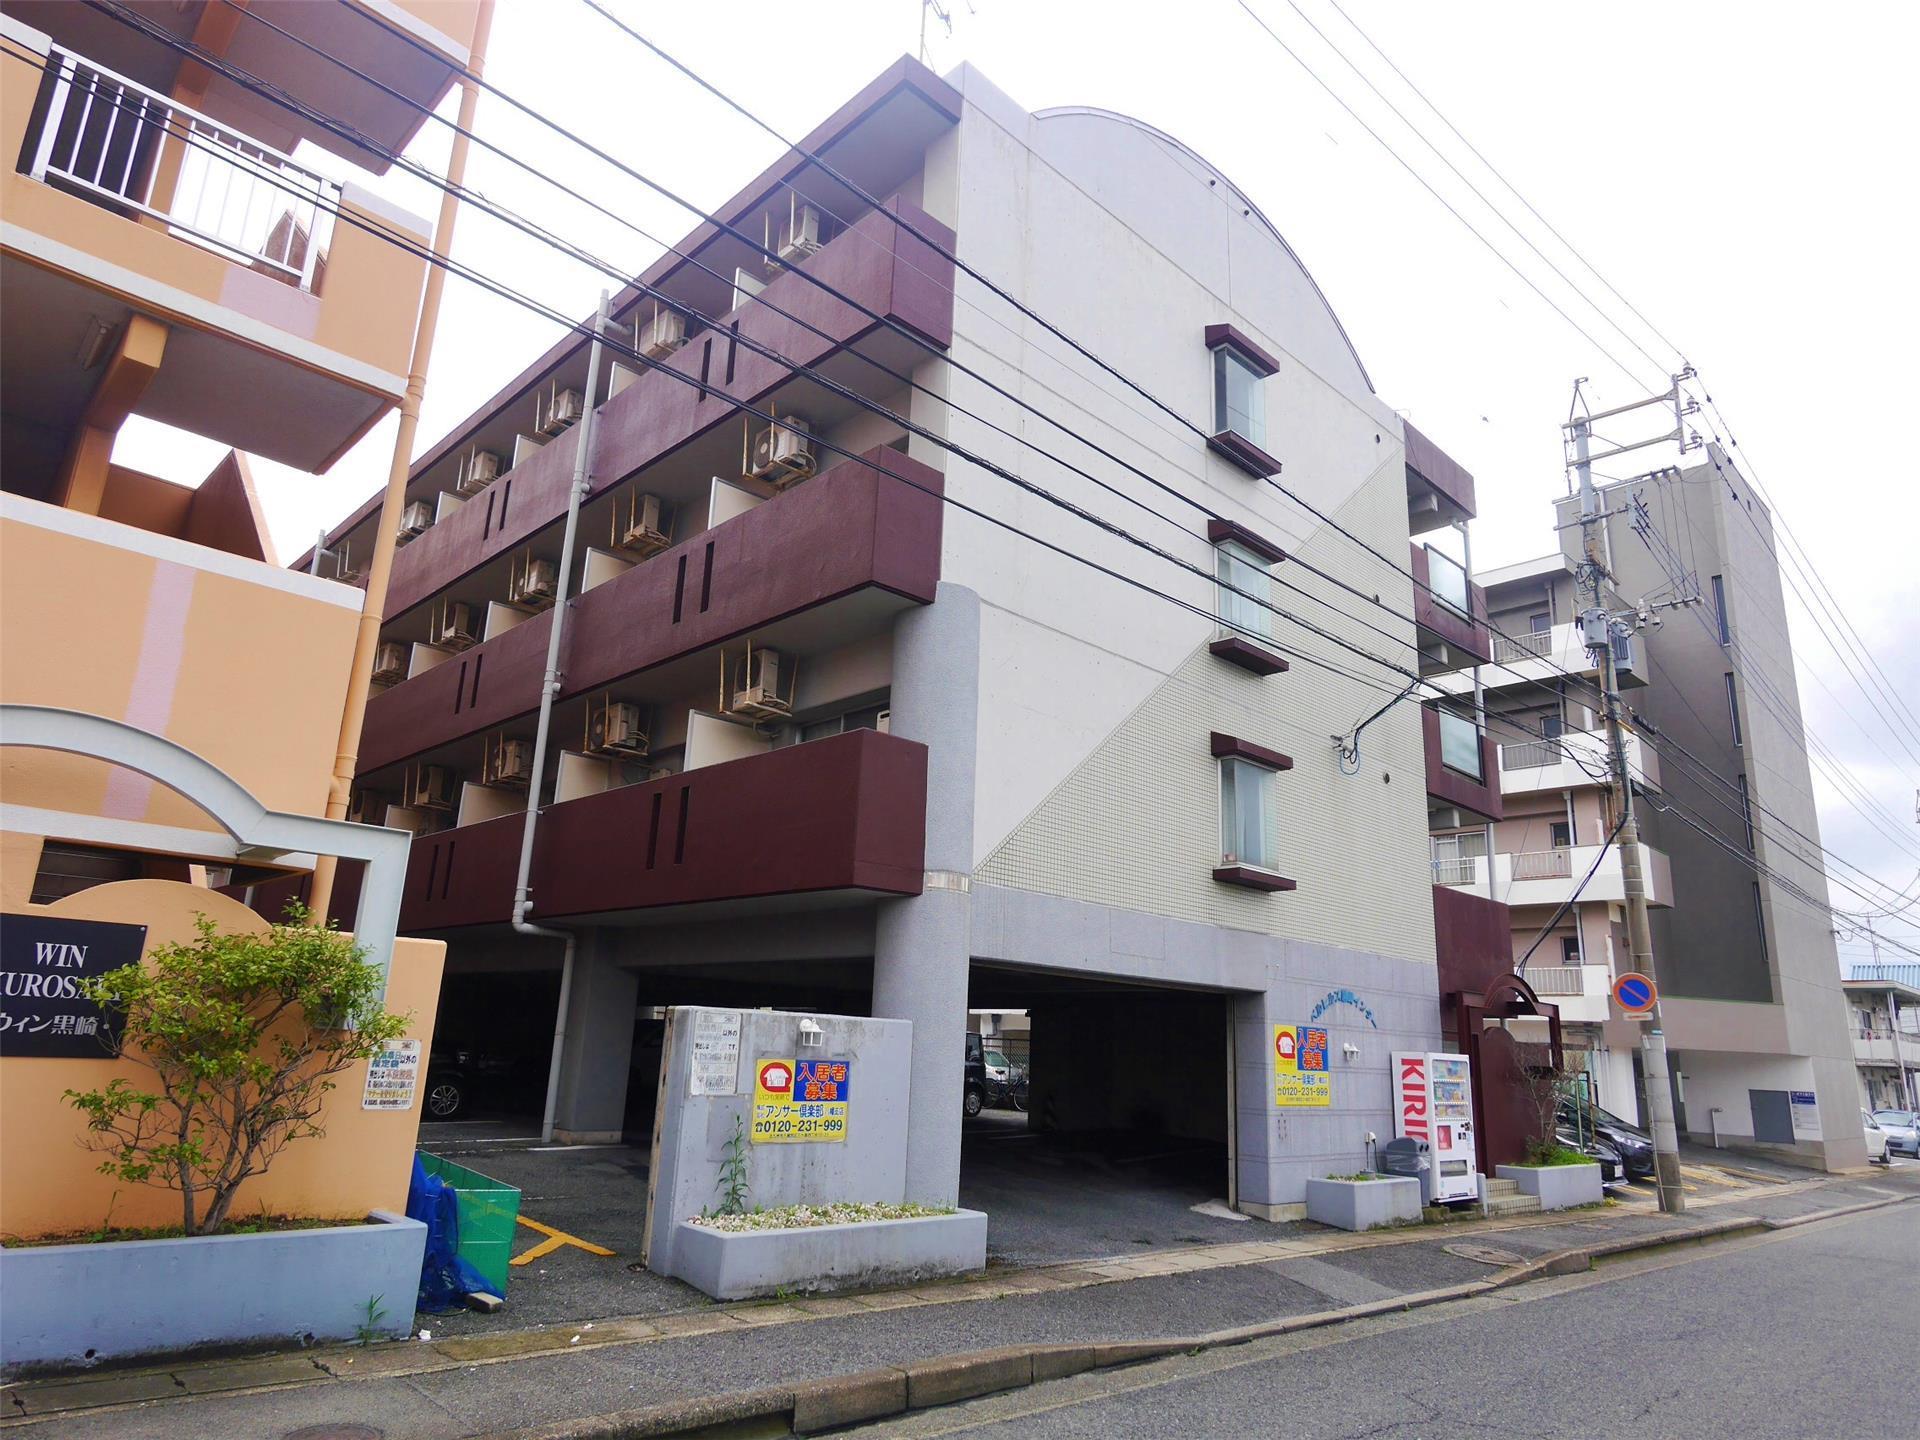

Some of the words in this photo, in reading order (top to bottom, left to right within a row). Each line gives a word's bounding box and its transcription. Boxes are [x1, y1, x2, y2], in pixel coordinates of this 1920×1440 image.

[35, 942, 88, 968] WIN
[0, 1012, 99, 1036] ウィン黒崎
[1297, 1029, 1327, 1049] 入居者
[1303, 1049, 1323, 1070] 募集
[797, 1062, 847, 1082] 入居者
[804, 1080, 837, 1100] 募集
[1282, 1086, 1328, 1096] 0120-231-999
[765, 1104, 823, 1118] アンサー倶楽部
[764, 1119, 843, 1133] 0120-231-999
